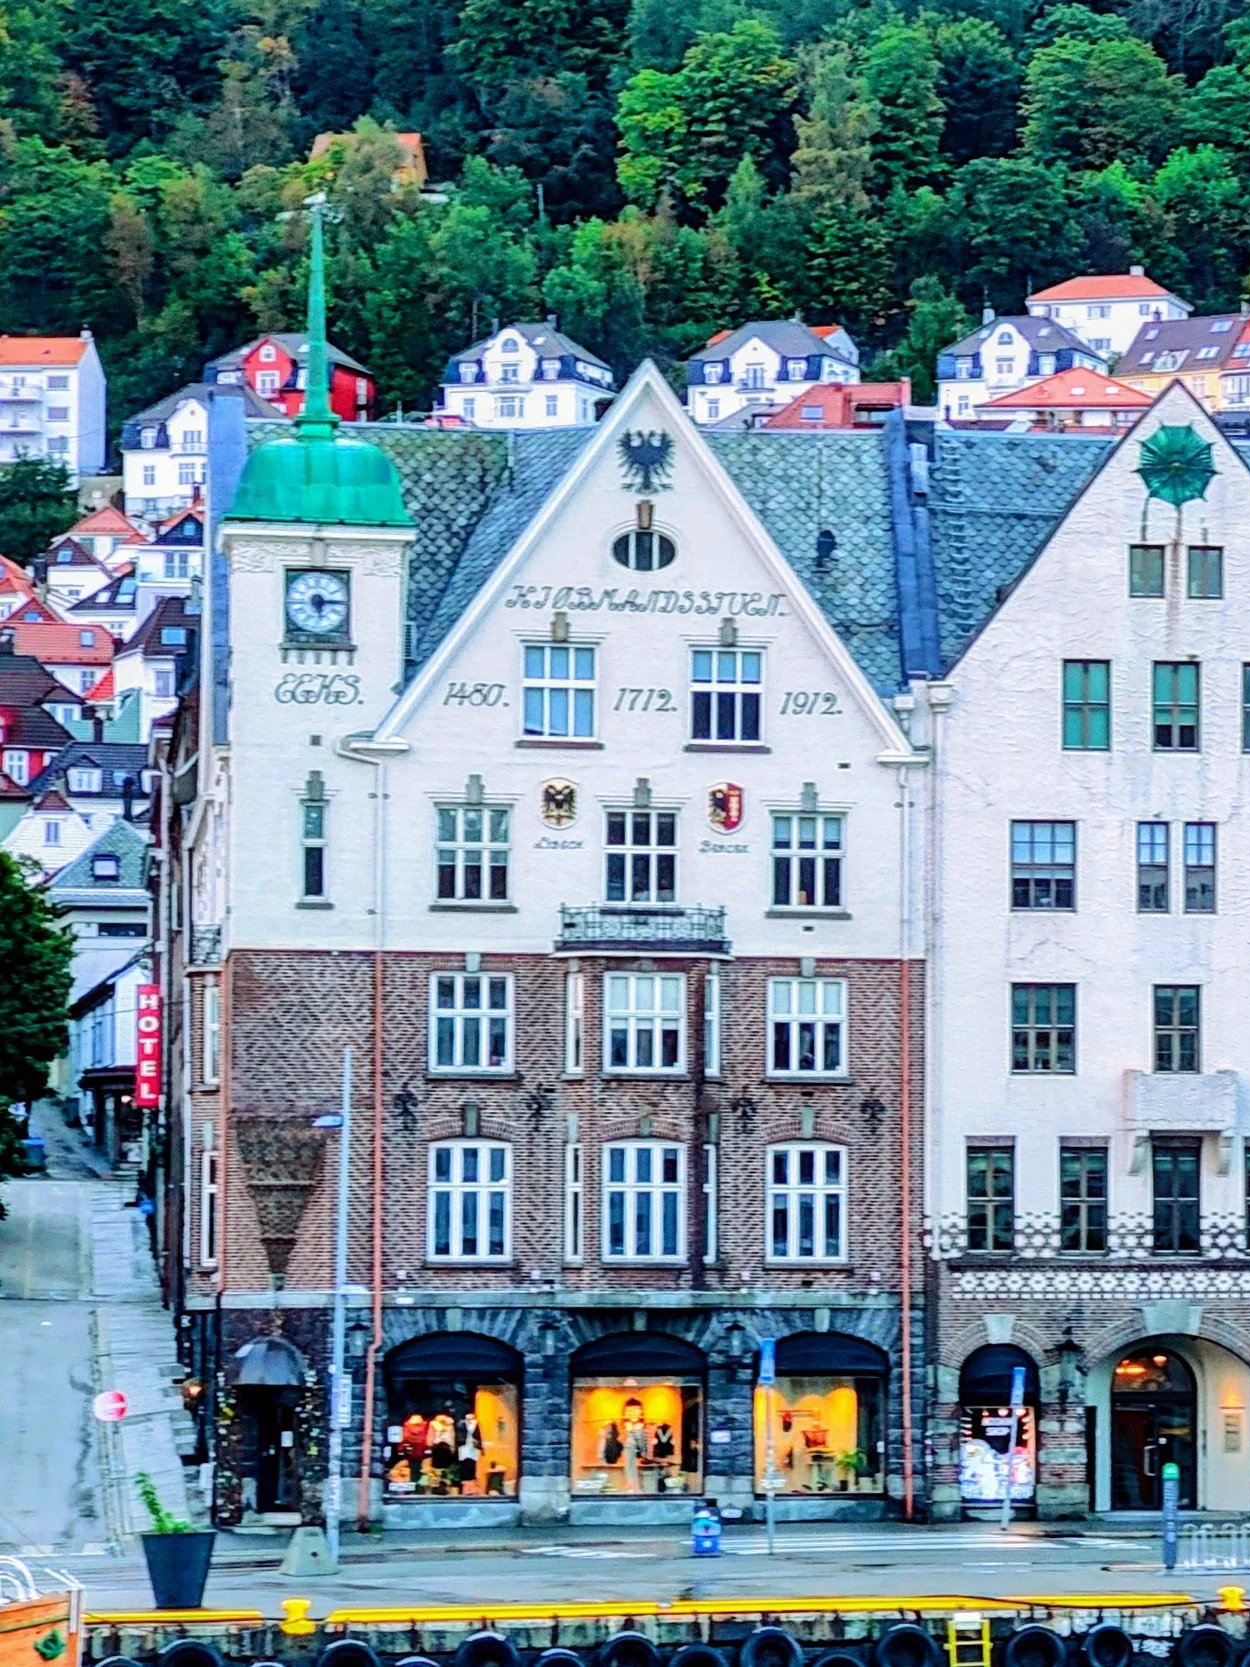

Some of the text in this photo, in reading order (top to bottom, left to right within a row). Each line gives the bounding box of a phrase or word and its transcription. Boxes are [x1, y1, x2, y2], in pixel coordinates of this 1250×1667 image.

[612, 687, 678, 712] 1712.
[779, 691, 844, 715] 1912.
[139, 993, 159, 1100] HOTEL
